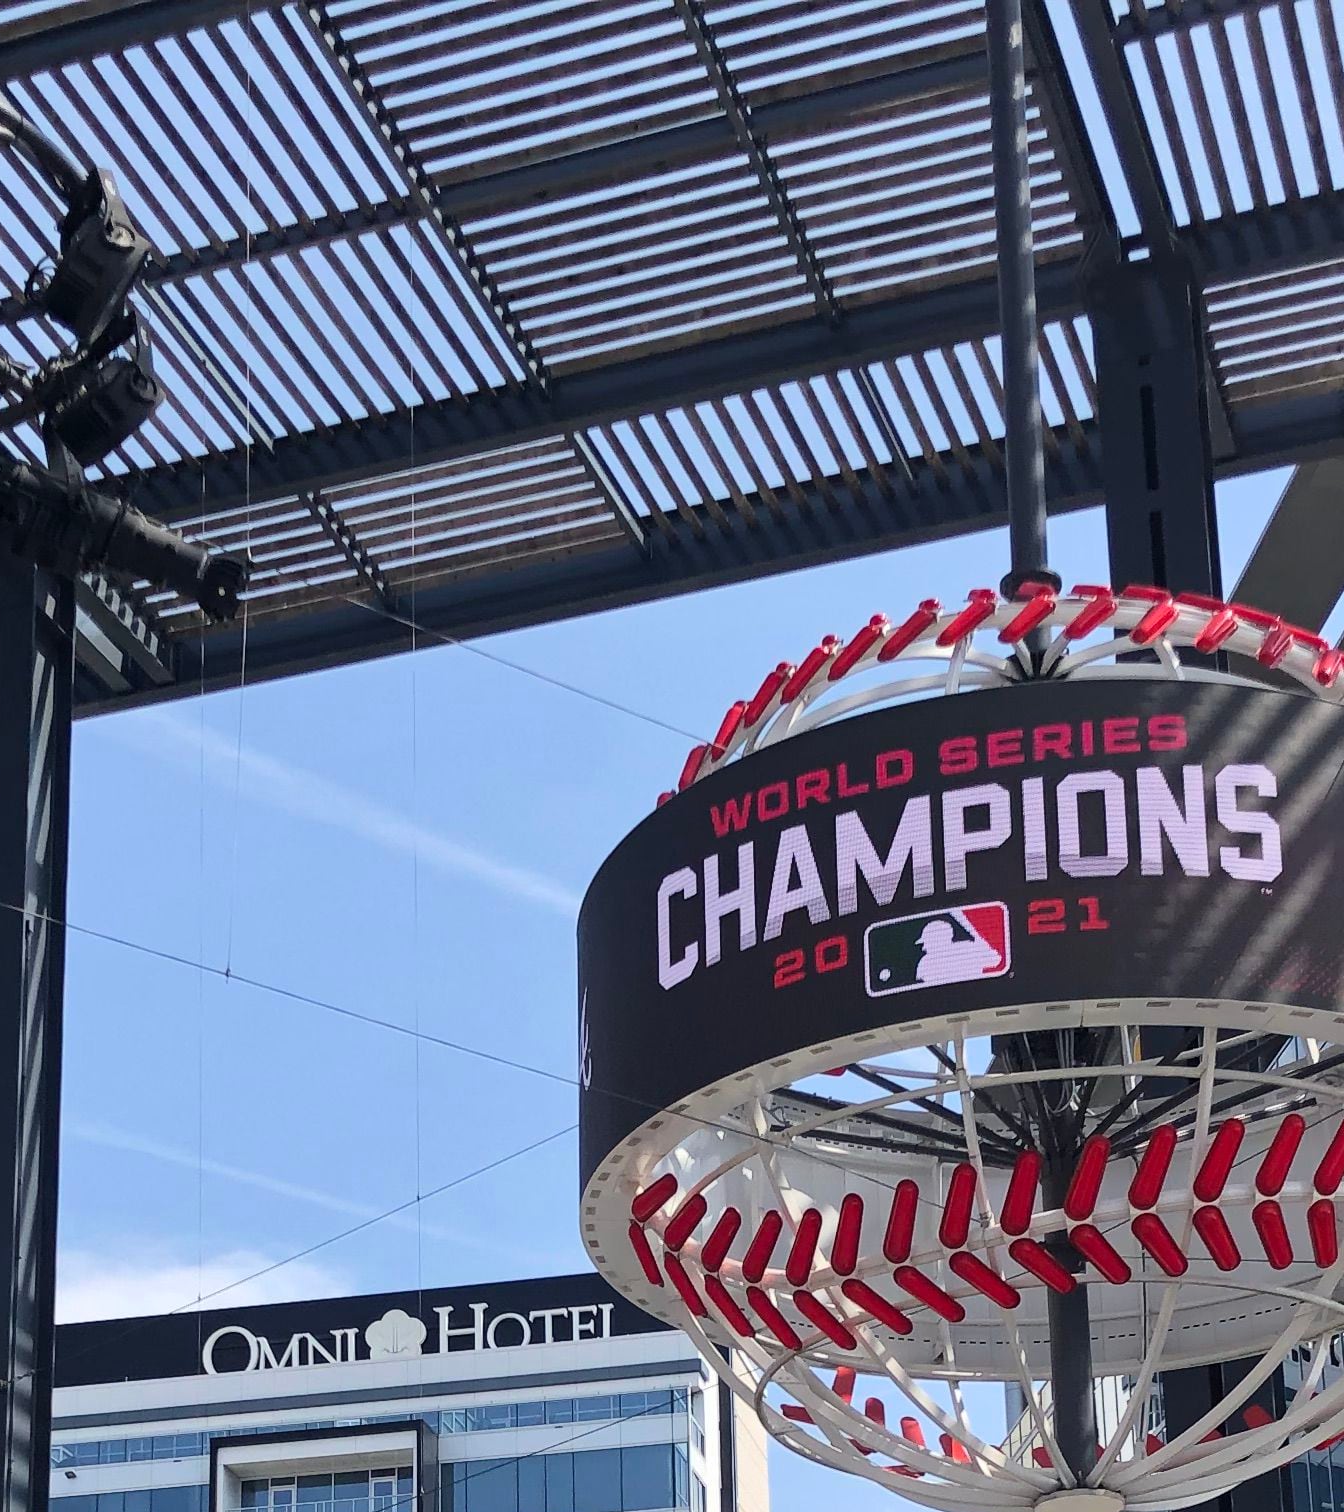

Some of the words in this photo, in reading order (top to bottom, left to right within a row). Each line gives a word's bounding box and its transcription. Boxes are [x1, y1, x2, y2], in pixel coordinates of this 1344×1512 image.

[710, 750, 914, 838] WORLD
[939, 715, 1188, 776] SERIES
[657, 763, 1284, 992] CHAMPIONS
[773, 935, 849, 989] 20
[1027, 896, 1111, 936] 21
